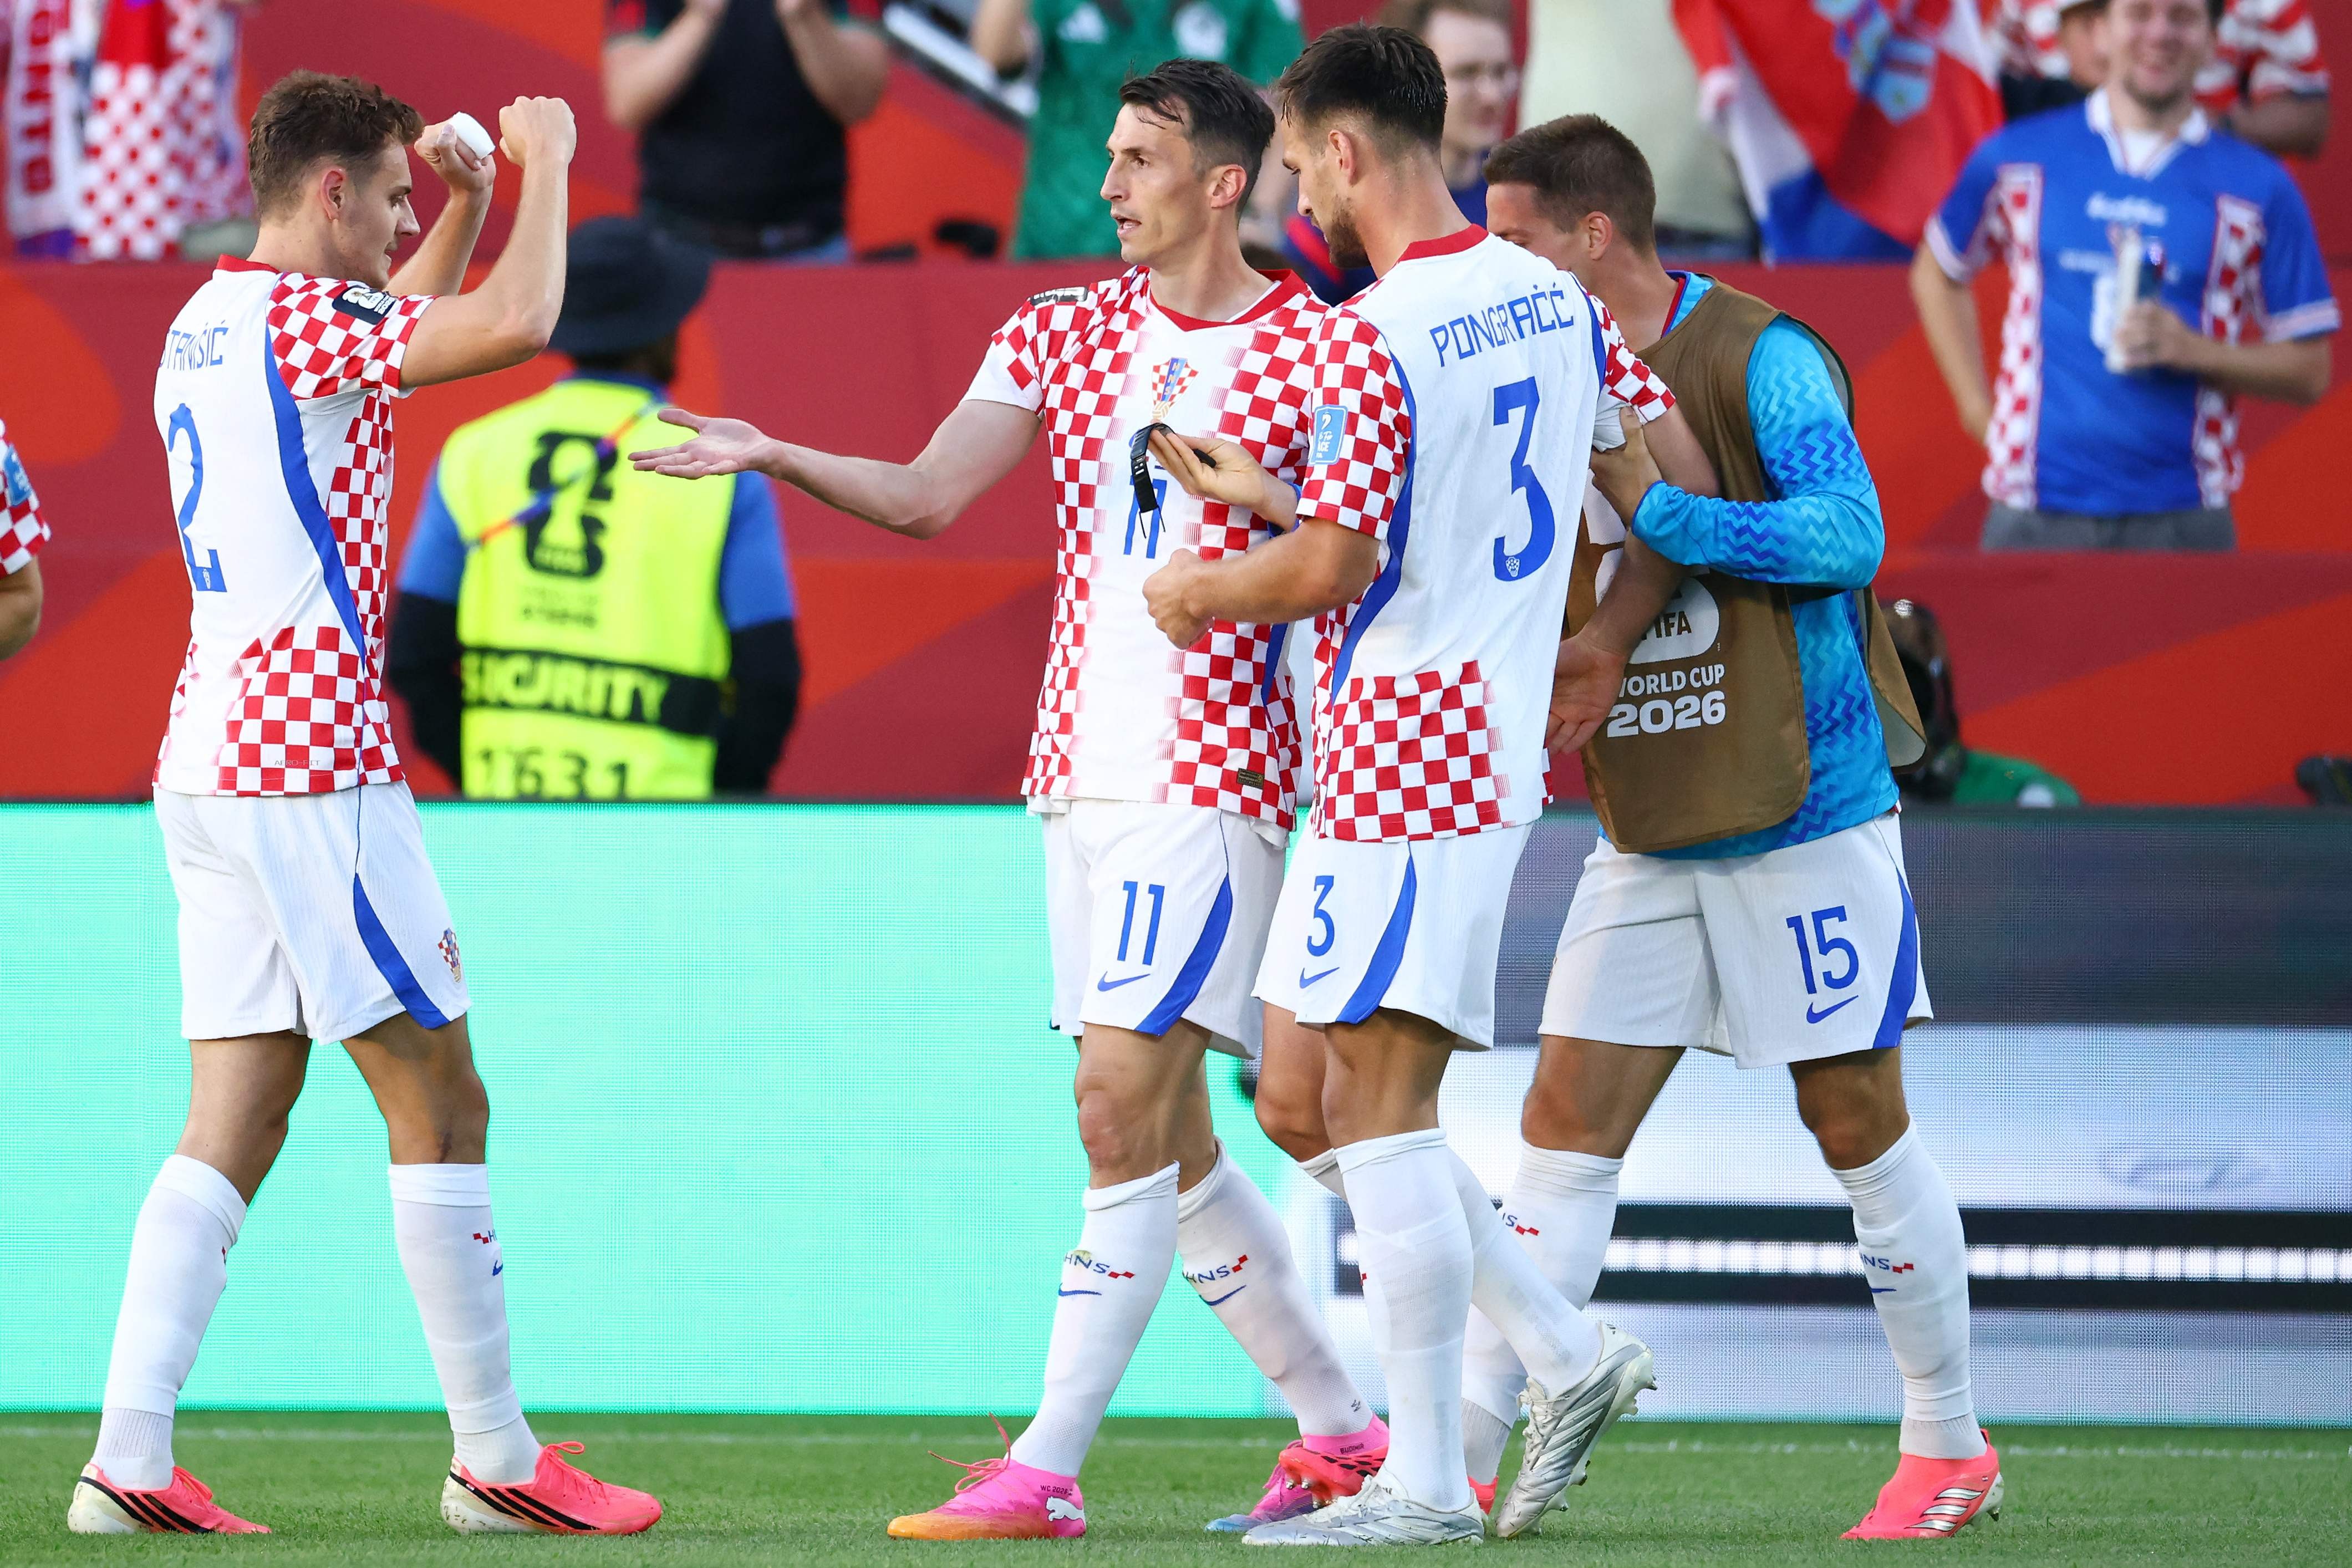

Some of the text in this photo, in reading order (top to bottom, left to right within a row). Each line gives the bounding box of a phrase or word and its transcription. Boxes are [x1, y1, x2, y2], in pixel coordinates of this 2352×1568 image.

[169, 403, 227, 592] 2
[1494, 376, 1555, 582] 3
[1641, 610, 1692, 640] IFA
[1607, 690, 1726, 738] 2026
[1690, 664, 1725, 689] CUP
[1117, 880, 1165, 966] 11
[1307, 875, 1335, 957] 3
[1785, 905, 1859, 995] 15
[1064, 1252, 1110, 1274] HNS
